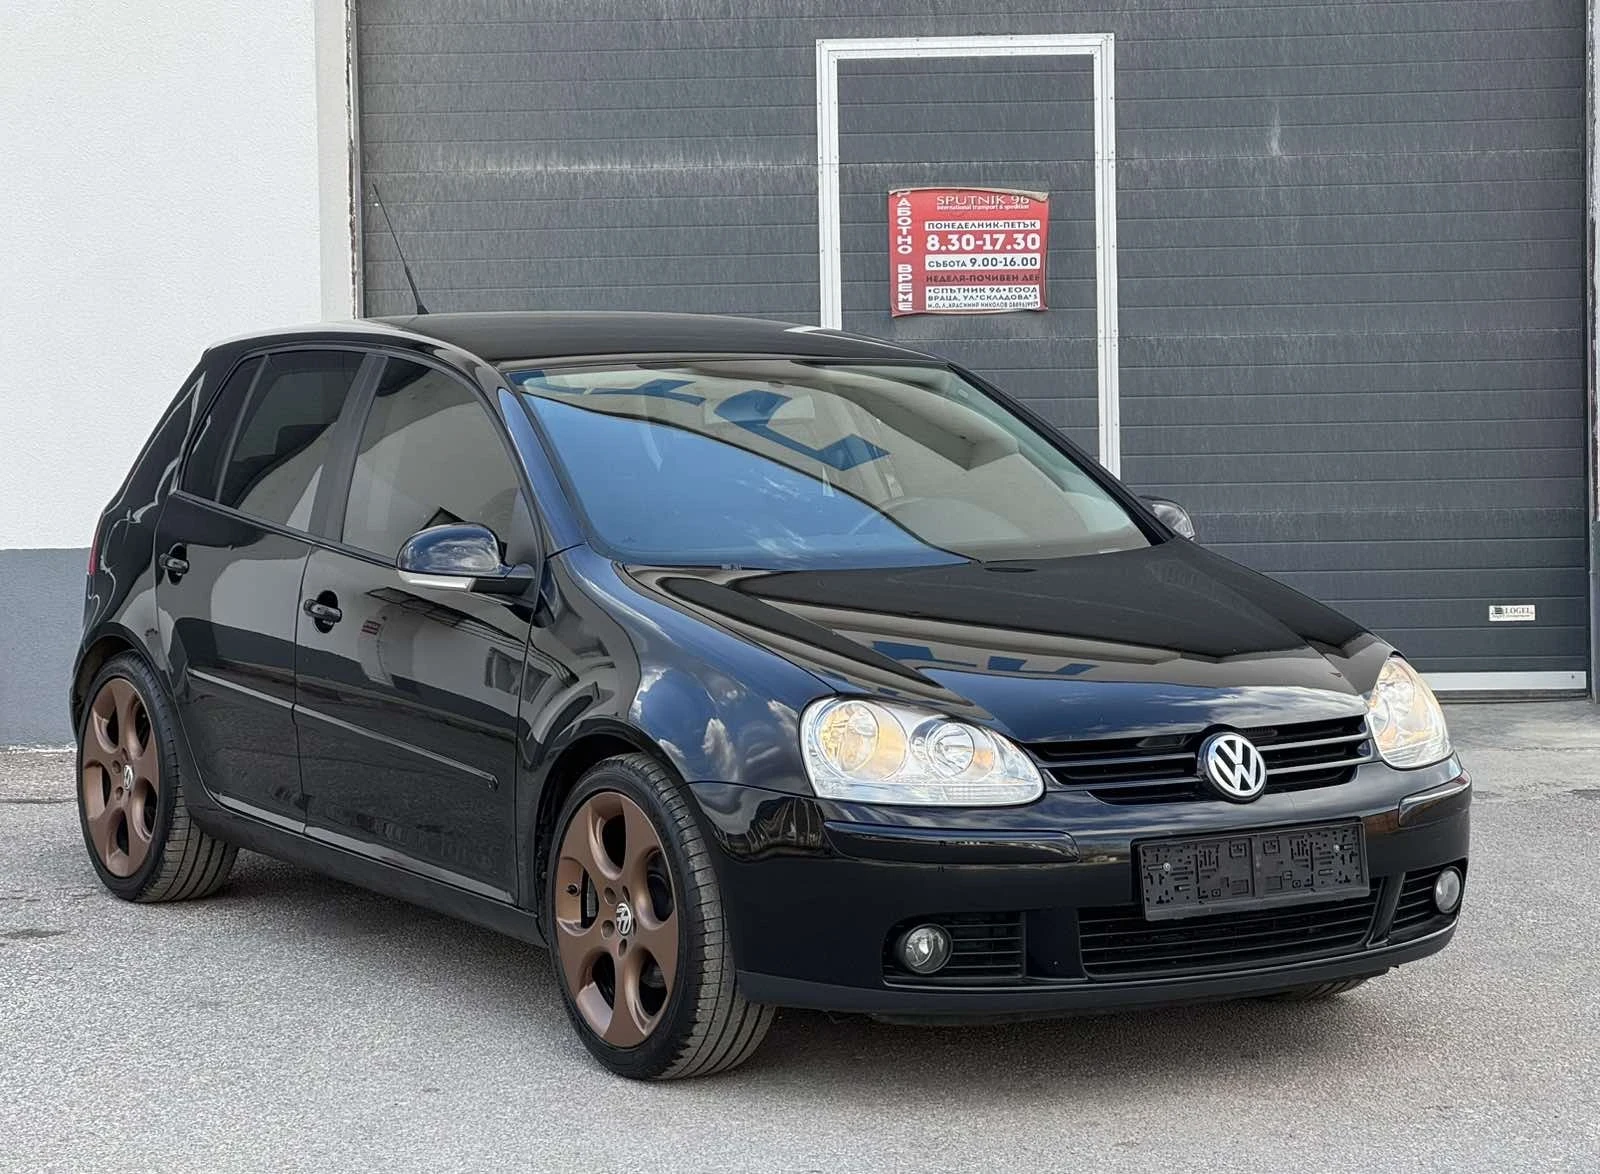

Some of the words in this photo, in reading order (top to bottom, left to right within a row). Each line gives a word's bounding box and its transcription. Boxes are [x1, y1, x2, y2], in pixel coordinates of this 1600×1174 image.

[936, 195, 1006, 205] SPUTNIK
[1011, 195, 1030, 205] 96
[928, 222, 1037, 230] ПОНЕДЕЛНИК-ПЕТЪК
[926, 233, 1041, 251] 8.30-17.30
[928, 260, 967, 268] СЪБОТА
[969, 257, 1037, 267] 9.00-16.00
[926, 274, 1019, 283] НЕДЕЛЯ-ПОЧИВЕН
[897, 264, 913, 311] ВРЕМЕ
[1208, 734, 1266, 796] VW
